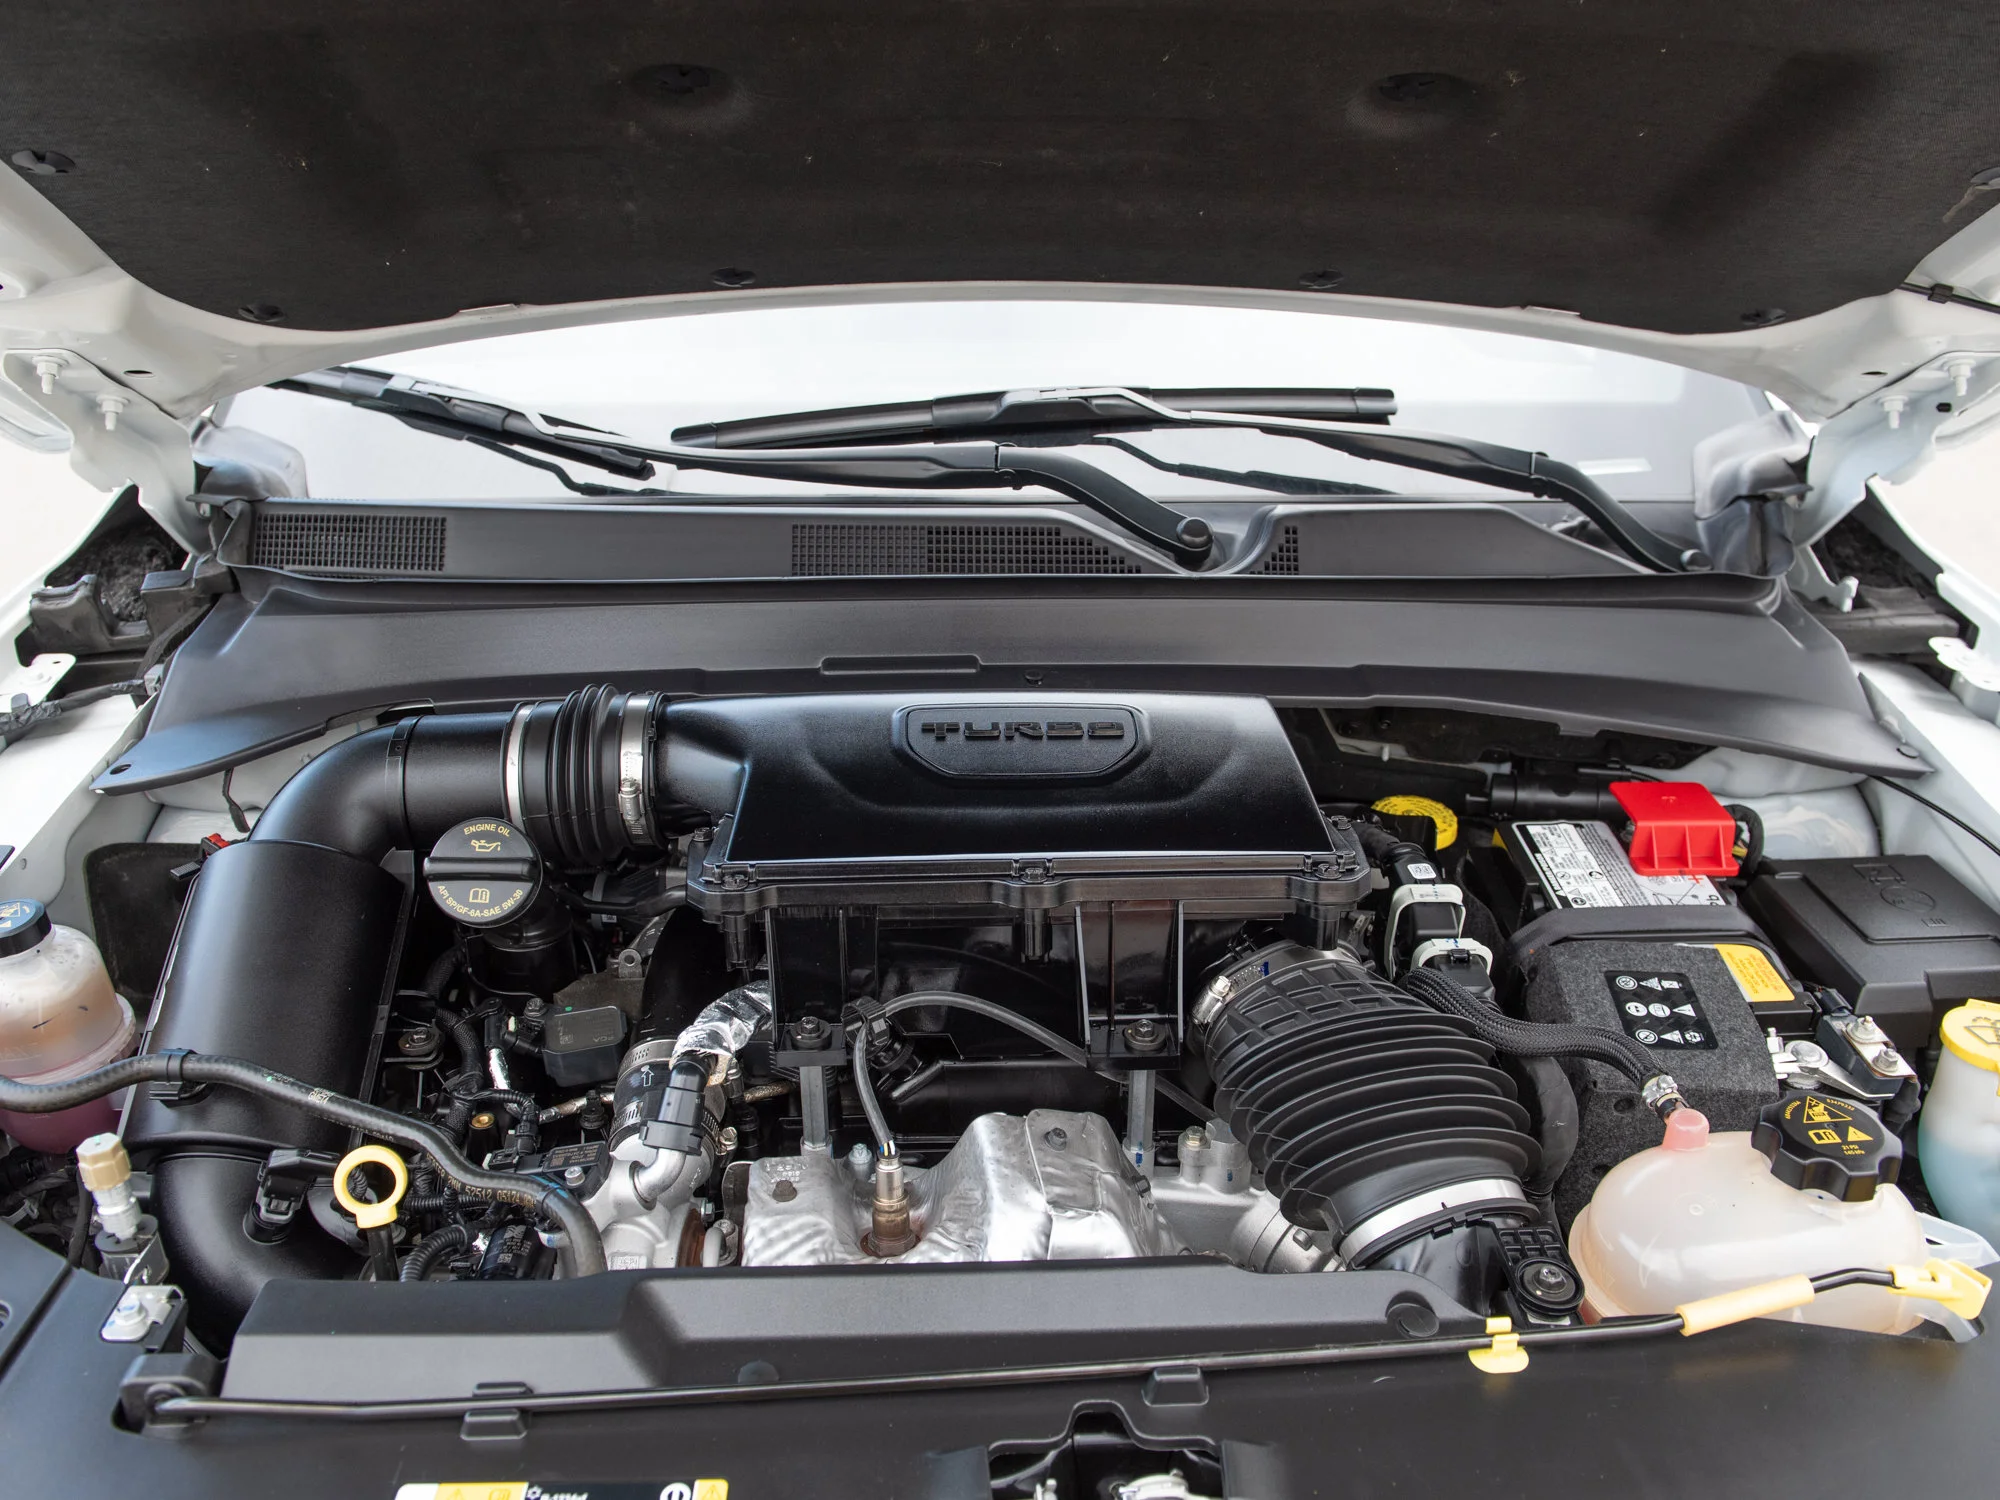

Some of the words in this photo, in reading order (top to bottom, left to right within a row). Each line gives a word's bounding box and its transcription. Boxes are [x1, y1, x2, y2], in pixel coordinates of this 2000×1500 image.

[921, 721, 1125, 739] TURBO
[463, 823, 497, 835] ENGINE
[497, 825, 510, 837] OIL
[437, 884, 449, 899] API
[446, 896, 502, 918] SP/GF-6A-SAE
[501, 888, 524, 910] 5W-30
